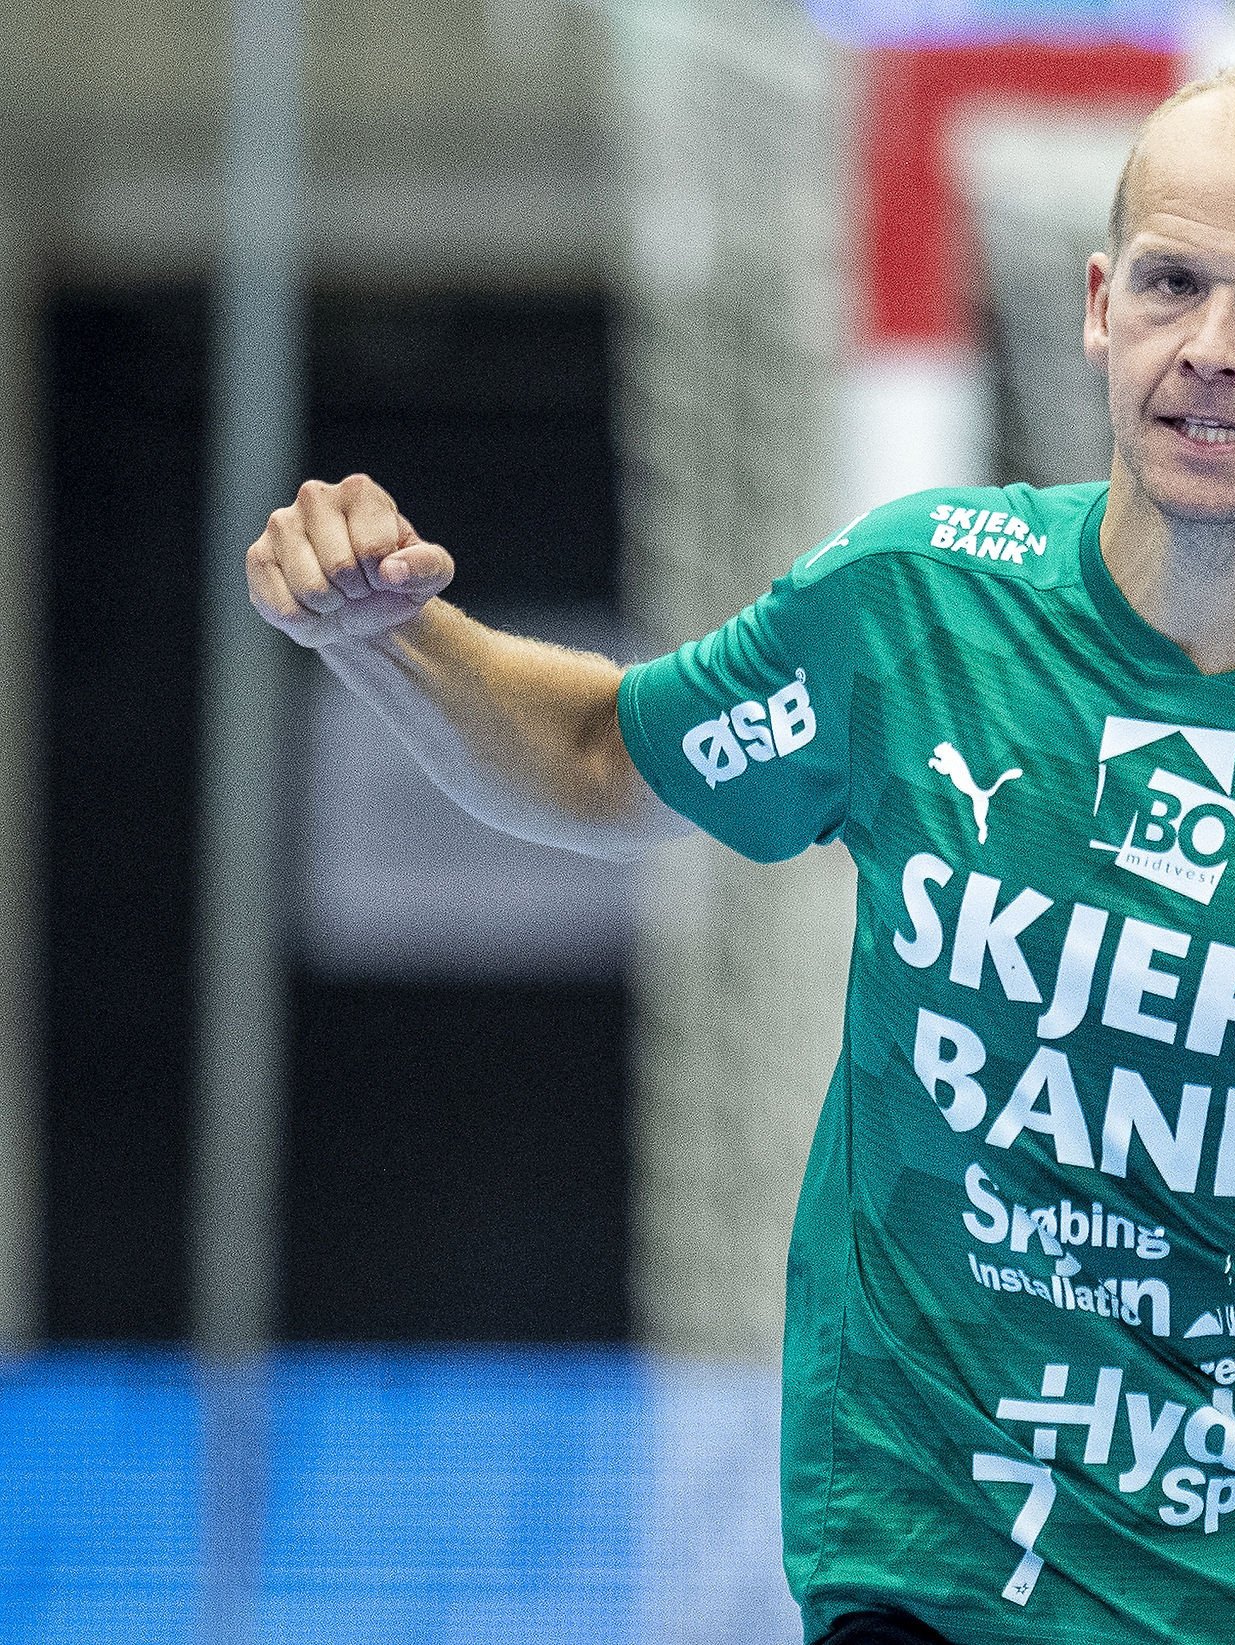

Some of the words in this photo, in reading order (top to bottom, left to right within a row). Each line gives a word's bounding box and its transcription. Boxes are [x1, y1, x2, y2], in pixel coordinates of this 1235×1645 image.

[929, 504, 1047, 556] SKJERN
[930, 523, 1028, 565] BANK
[1126, 853, 1215, 884] midtvest
[972, 1454, 1056, 1607] 7
